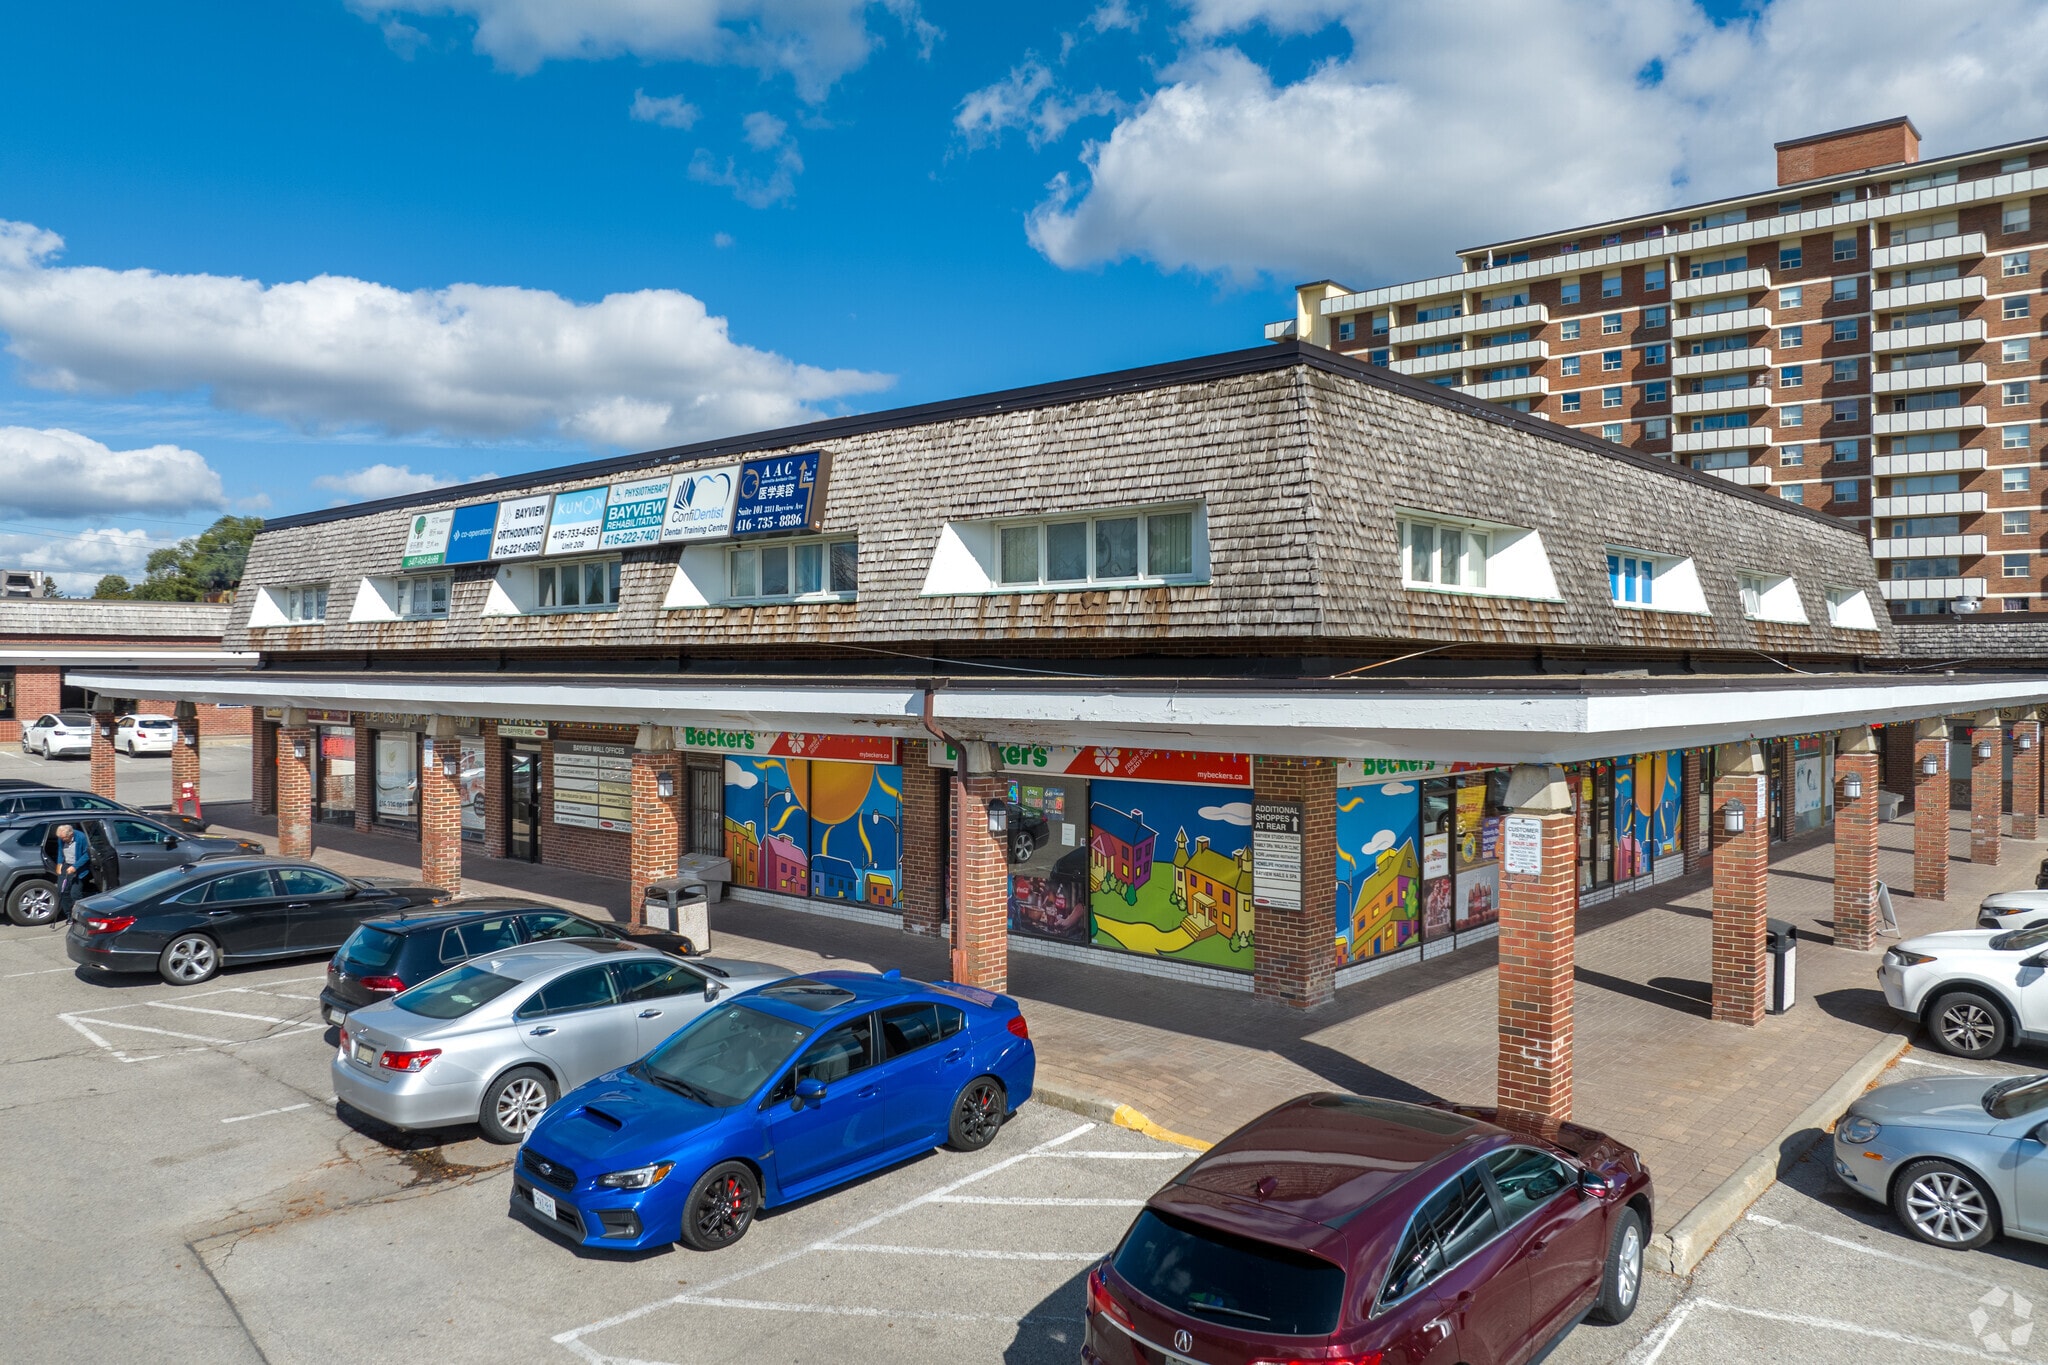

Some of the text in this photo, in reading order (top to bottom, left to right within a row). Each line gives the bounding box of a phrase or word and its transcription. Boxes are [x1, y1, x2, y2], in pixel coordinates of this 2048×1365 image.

[624, 482, 670, 498] PHYSIOTHERAPY
[758, 484, 795, 500] 医学美容
[515, 505, 546, 519] BAYVIEW
[557, 495, 604, 515] KUMON
[609, 499, 665, 521] BAYVIEW
[738, 507, 752, 516] Suite
[753, 505, 763, 515] 101
[775, 503, 793, 513] Bayview
[672, 506, 725, 523] ConfiDentist
[606, 514, 663, 530] REHABILITATION
[461, 528, 493, 539] co-operators
[497, 525, 545, 540] ORTHODONTICS
[552, 525, 599, 540] 416-733-4563
[604, 528, 660, 545] 416-222-7401
[664, 523, 728, 536] Dental Training Centre
[495, 541, 541, 556] 416-221-0660
[561, 540, 585, 550] Unit 208
[573, 744, 625, 755] BAYVIEW MALL OFFICES
[1197, 771, 1243, 780] mybeckers.ca
[1255, 805, 1299, 815] ADDITIONAL
[1255, 813, 1290, 823] SHOPPES
[1266, 822, 1287, 831] REAR
[1508, 826, 1539, 834] CUSTOMER
